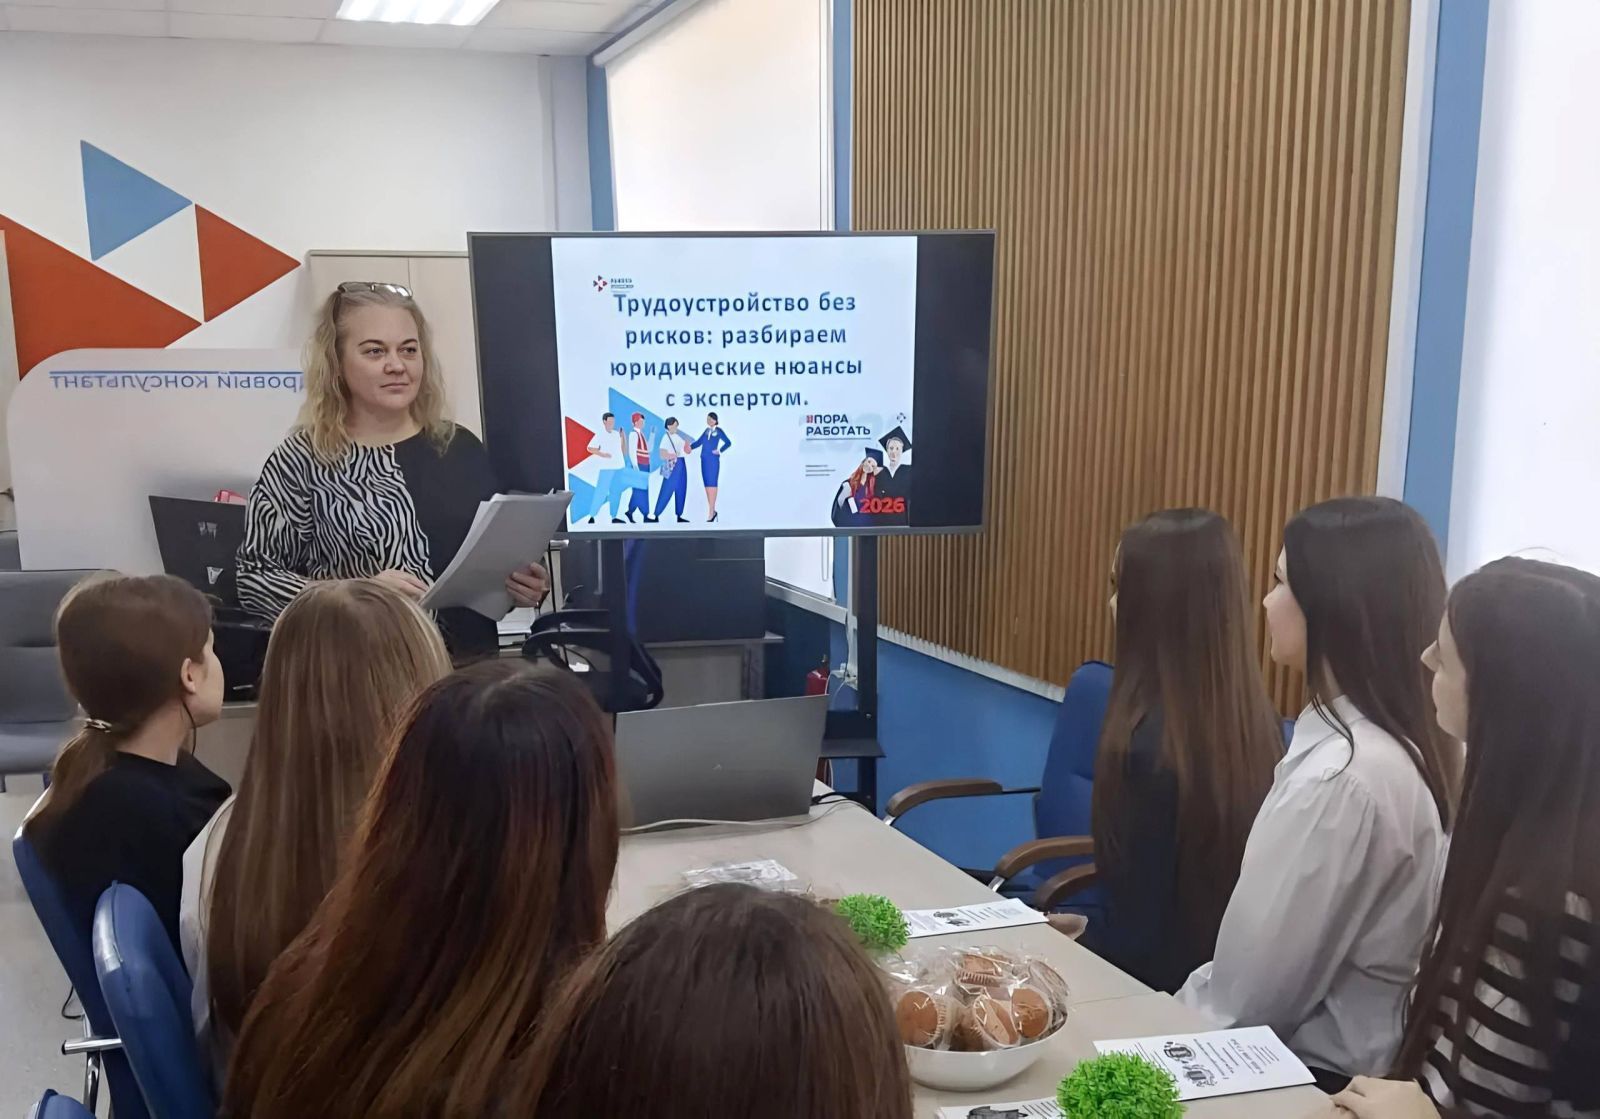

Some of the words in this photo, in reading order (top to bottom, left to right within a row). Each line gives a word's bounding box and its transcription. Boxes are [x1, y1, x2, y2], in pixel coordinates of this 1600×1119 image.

[613, 292, 809, 316] Трудоустройство
[819, 292, 856, 311] без
[625, 329, 712, 348] рисков:
[722, 325, 846, 348] разбираем
[611, 361, 765, 380] юридические
[775, 360, 862, 375] нюансы
[665, 393, 675, 407] с
[683, 392, 808, 410] экспертом.
[806, 426, 871, 436] РАБОТАТЬ
[860, 497, 905, 513] 2026
